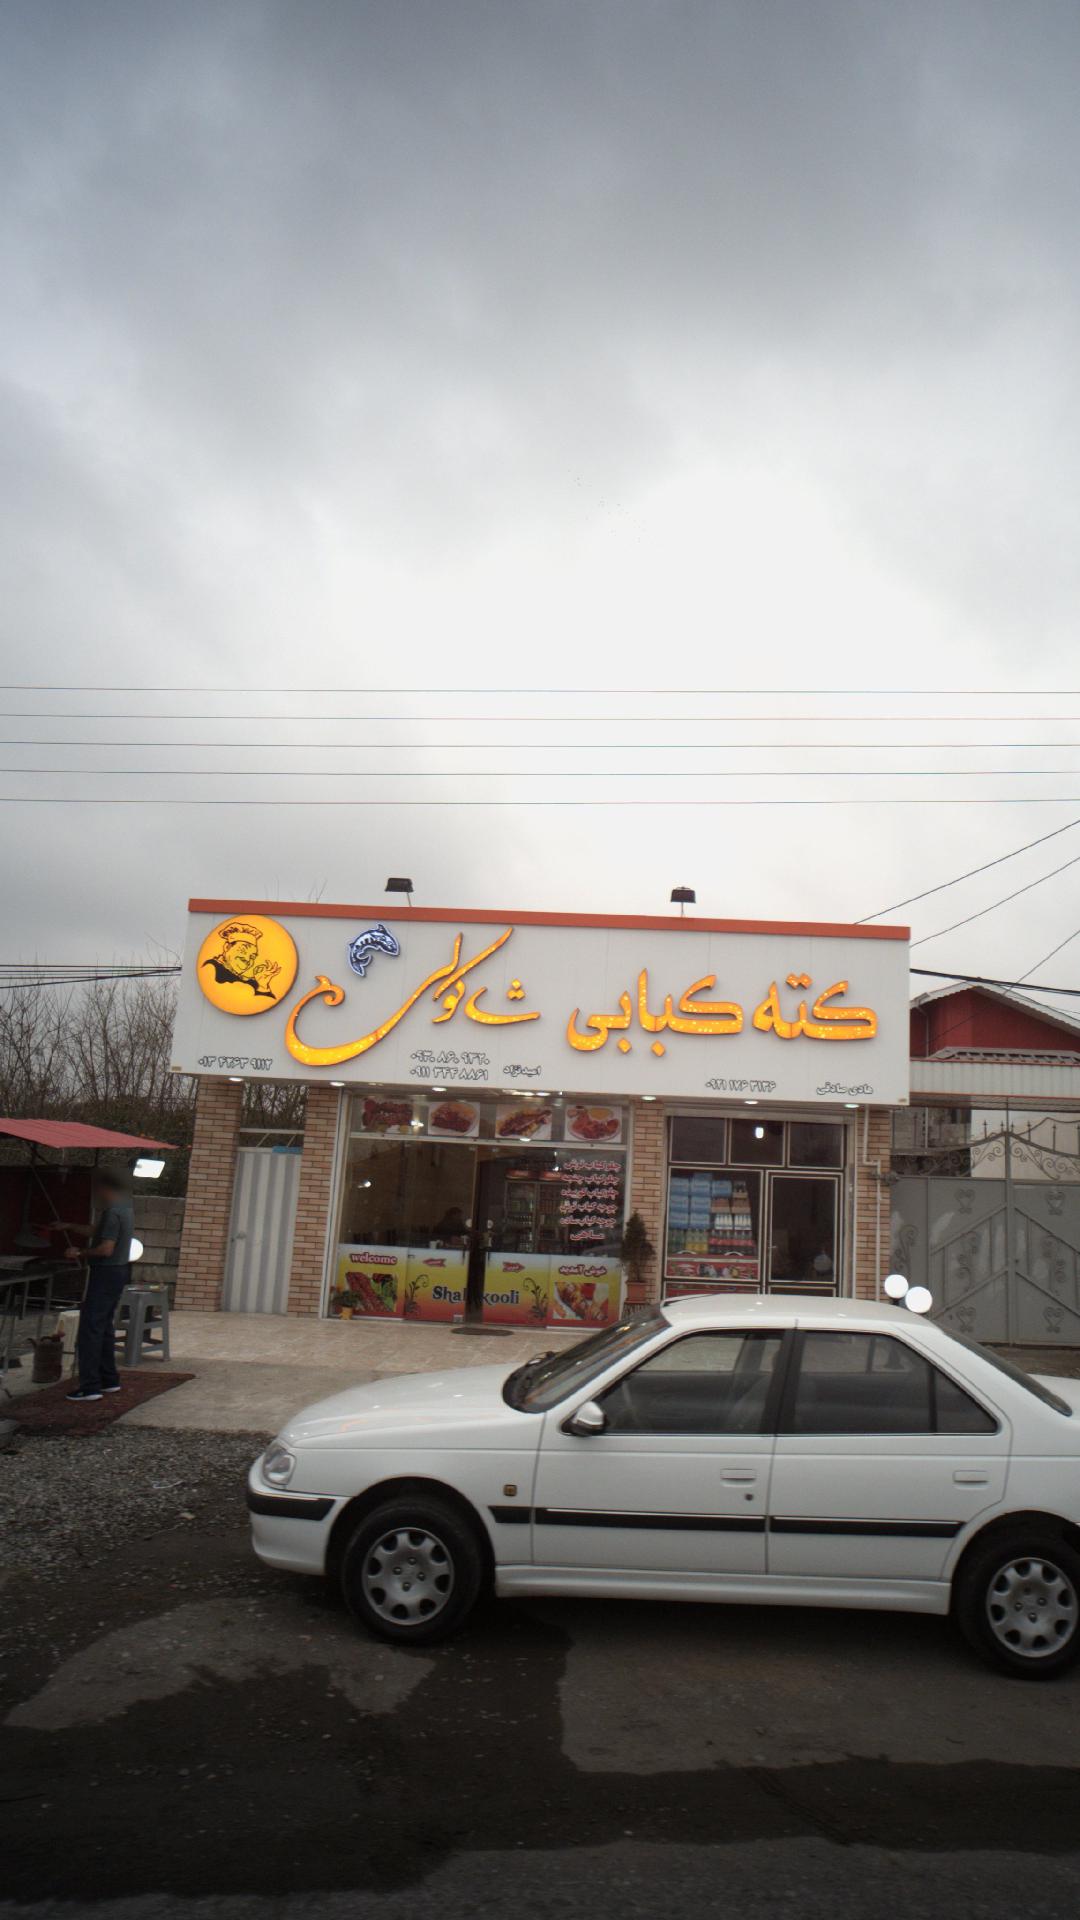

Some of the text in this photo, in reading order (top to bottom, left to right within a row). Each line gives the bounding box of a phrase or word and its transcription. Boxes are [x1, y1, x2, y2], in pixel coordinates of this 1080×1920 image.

[566, 967, 745, 1057] کبابی
[752, 972, 878, 1041] کته
[350, 1252, 398, 1265] welcome
[584, 1265, 608, 1278] خوش
